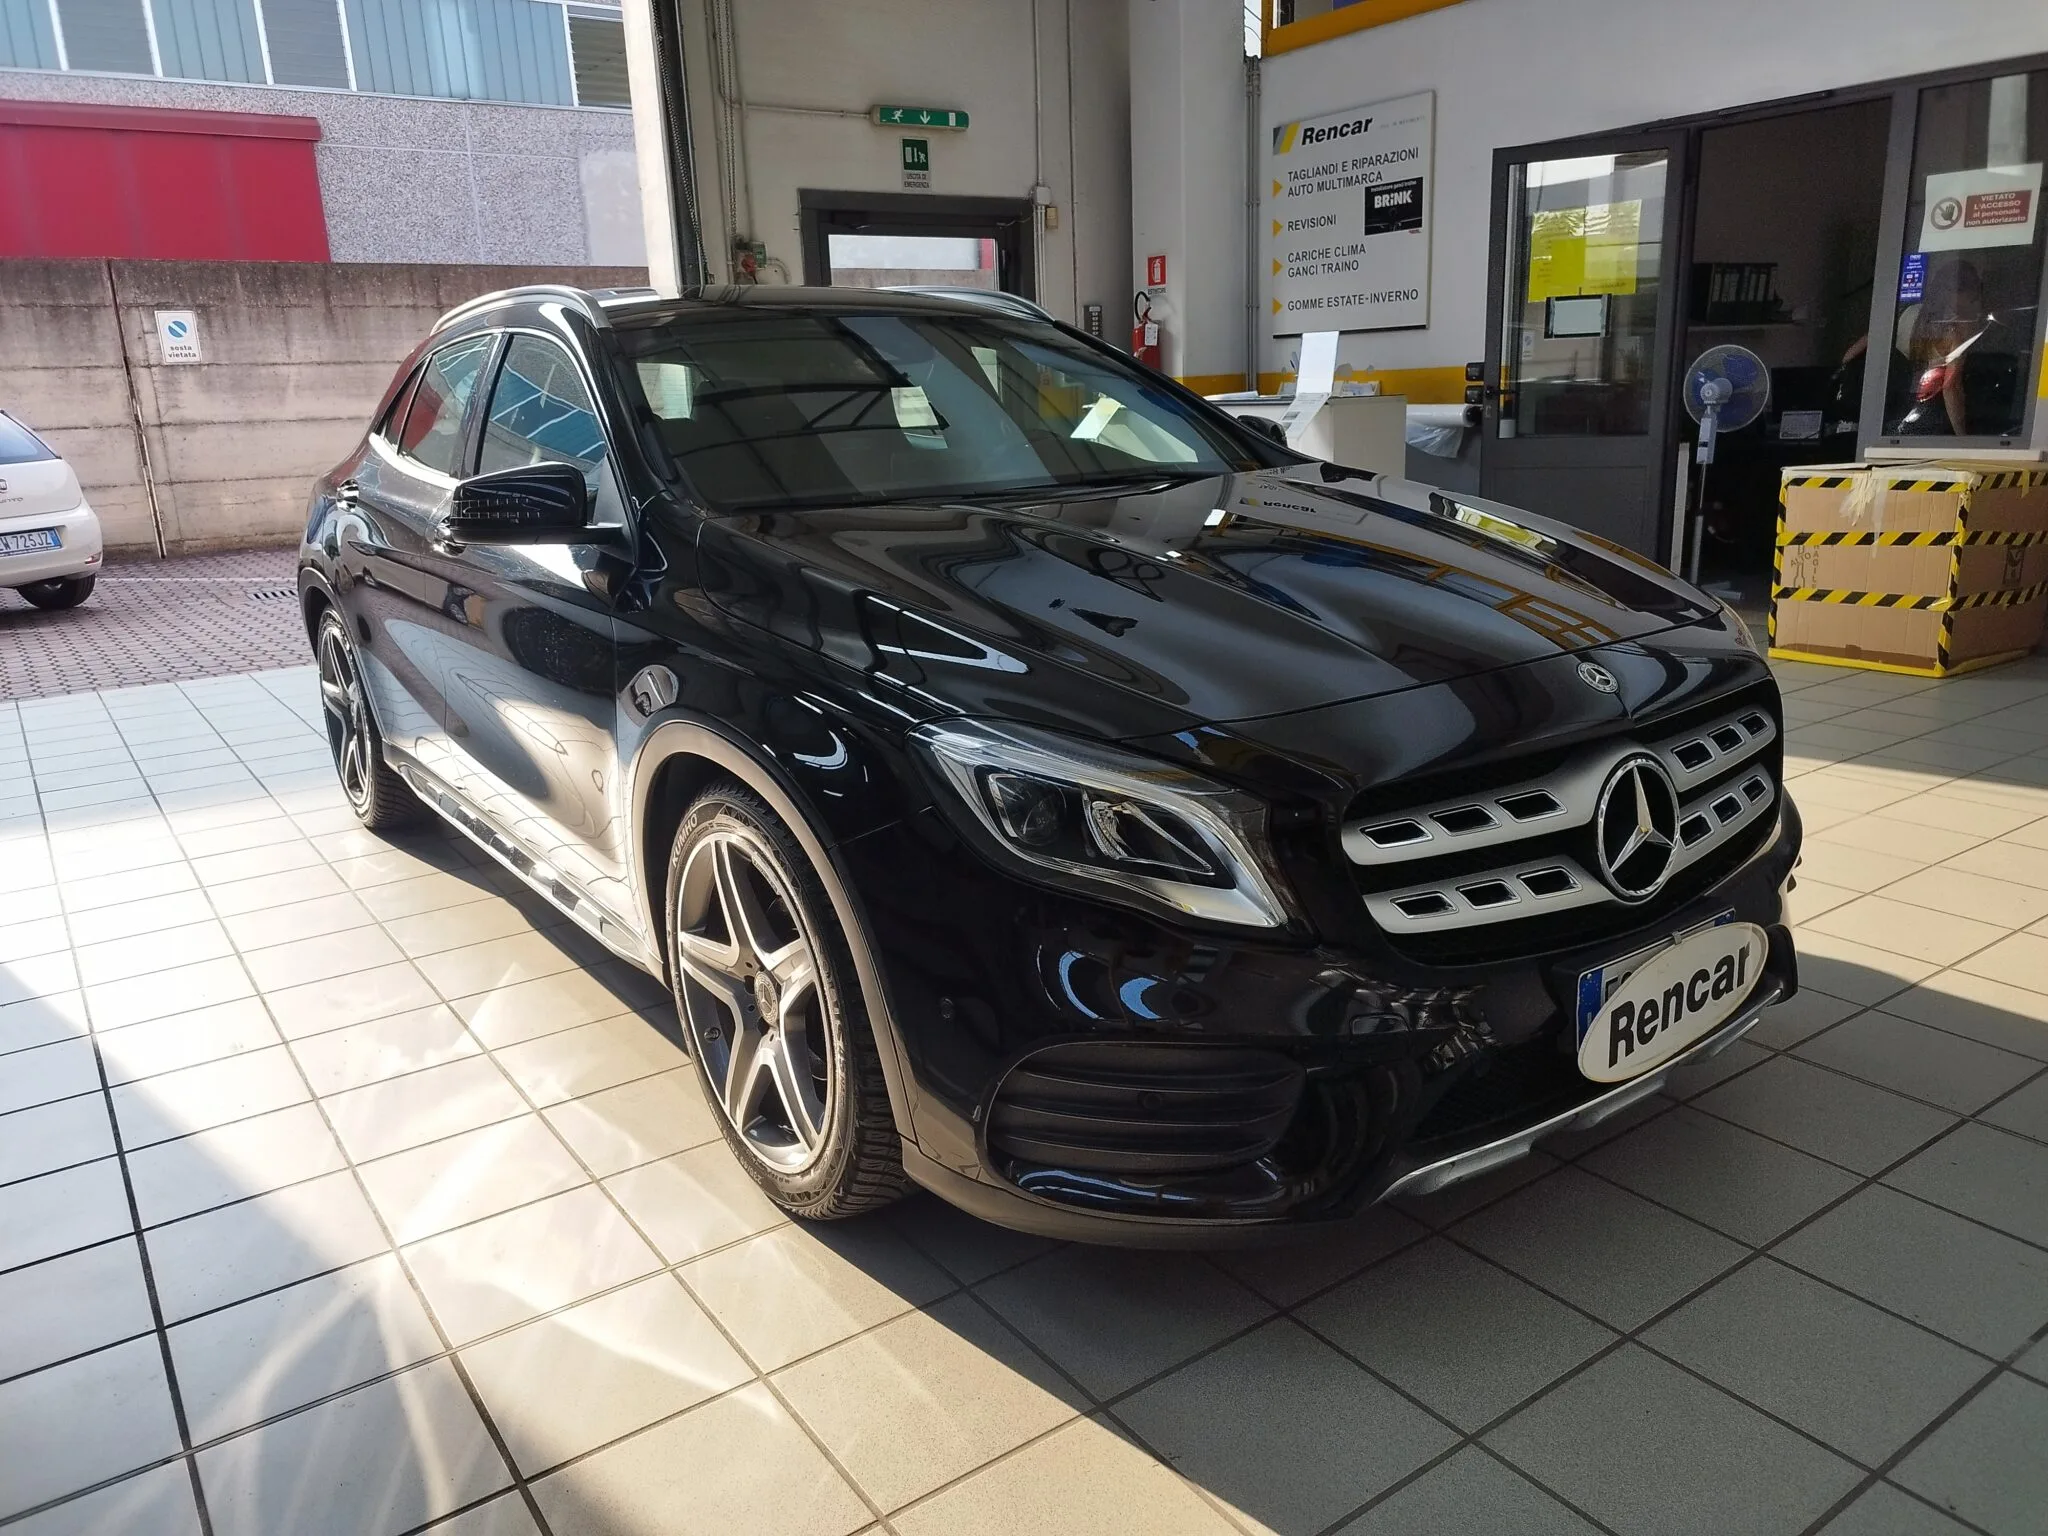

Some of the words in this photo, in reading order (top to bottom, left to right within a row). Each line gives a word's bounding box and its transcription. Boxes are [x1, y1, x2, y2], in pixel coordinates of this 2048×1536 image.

[1301, 117, 1373, 146] Rencar
[1288, 163, 1338, 182] TAGLIANDI
[1342, 161, 1348, 172] E
[1352, 147, 1419, 170] RIPARAZIONI
[1287, 183, 1313, 198] AUTO
[1317, 171, 1383, 192] MULTIMARCA
[1974, 200, 2021, 210] L'ACCESSO
[1981, 192, 2016, 201] VIETATO
[1287, 214, 1337, 232] REVISIONI
[1981, 208, 2020, 219] personale
[1982, 216, 2026, 225] autorizzato
[1288, 247, 1331, 263] CARICHE
[1334, 243, 1366, 257] CLIMA
[1288, 265, 1318, 278] GANCI
[1321, 260, 1359, 273] TRAINO
[1288, 297, 1324, 311] GOMME
[1327, 289, 1419, 308] ESTATE-INVERNO
[671, 813, 698, 868] KUMHO
[1608, 941, 1750, 1069] Rencar
